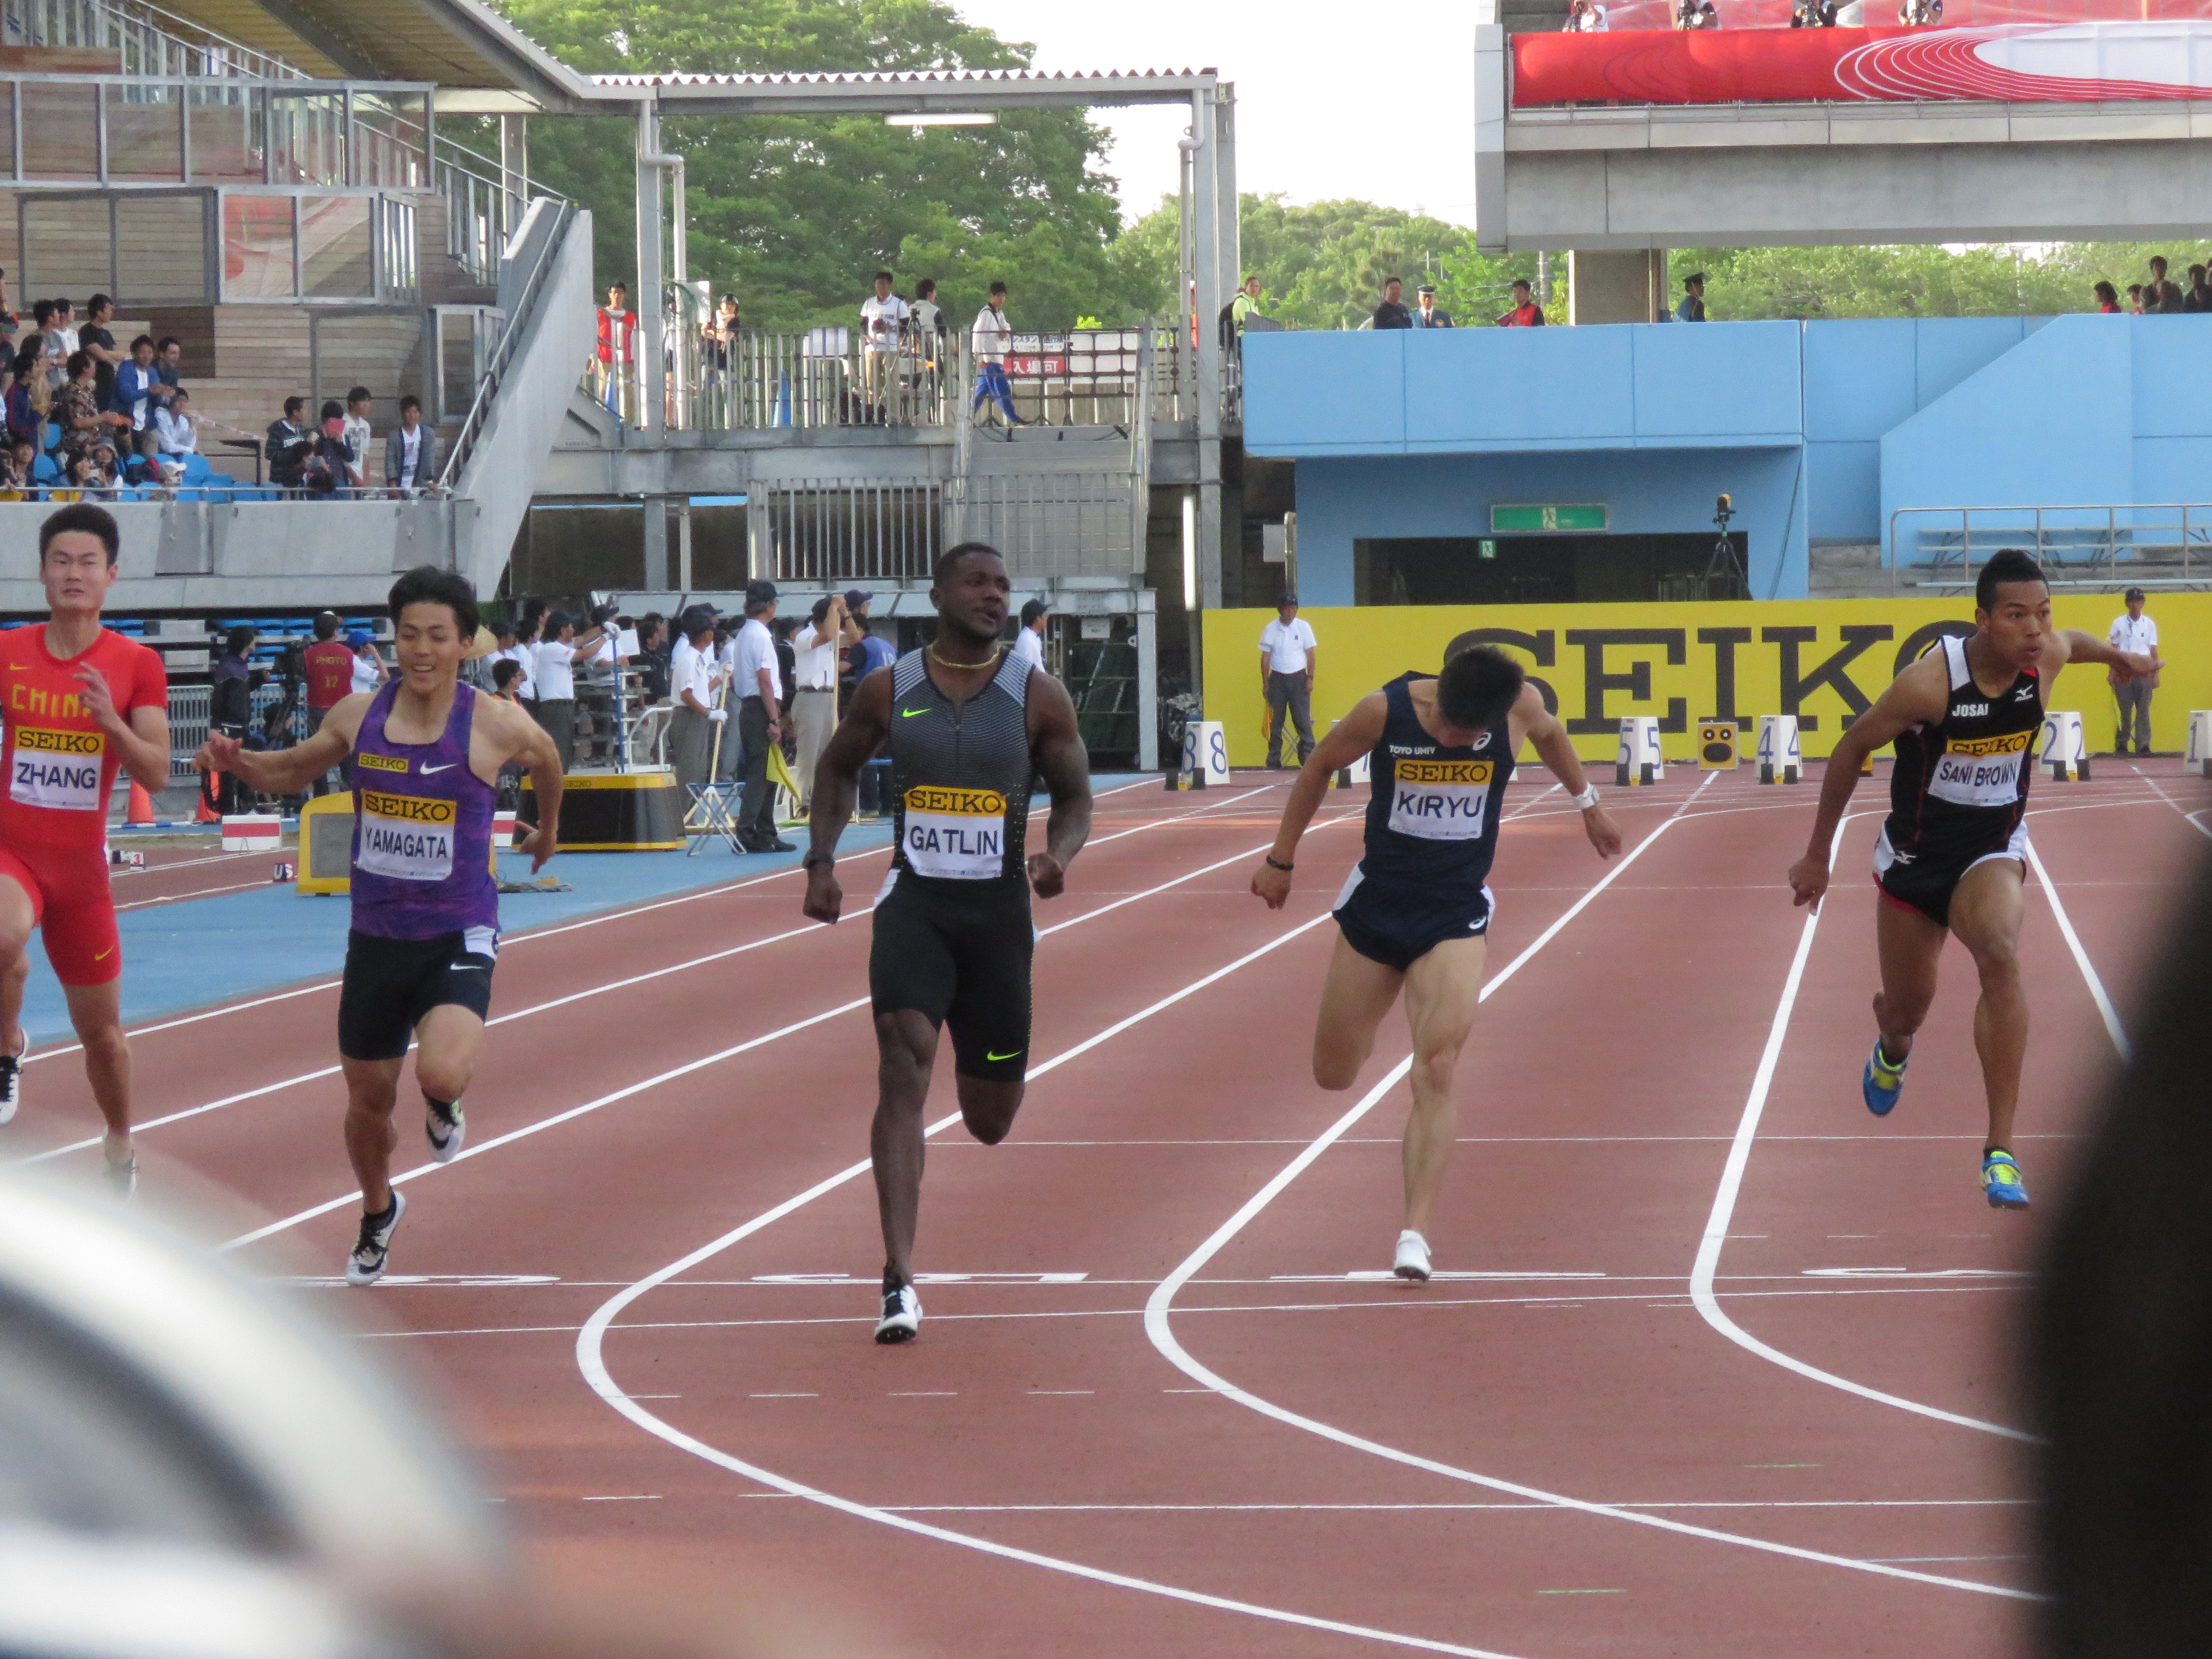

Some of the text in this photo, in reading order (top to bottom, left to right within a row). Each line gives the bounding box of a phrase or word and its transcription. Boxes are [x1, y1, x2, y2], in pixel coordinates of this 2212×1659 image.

[1443, 619, 1977, 734] SEIK
[1952, 703, 1989, 717] JOSAI
[19, 730, 100, 753] SEIKO
[1210, 731, 1226, 774] 8
[1389, 745, 1412, 755] TOYO
[1758, 725, 1774, 764] 4
[2041, 721, 2057, 764] 2
[2188, 721, 2199, 763] 1
[16, 762, 96, 789] ZHANG
[360, 755, 407, 770] SEIKO
[1399, 763, 1488, 782] SEIKO
[1940, 761, 2017, 787] SANI BROWN
[365, 793, 451, 821] SEIKO
[908, 789, 1002, 813] SEIKO
[1397, 791, 1483, 818] KIRYU
[365, 826, 448, 859] YAMAGATA
[910, 825, 998, 855] GATLIN
